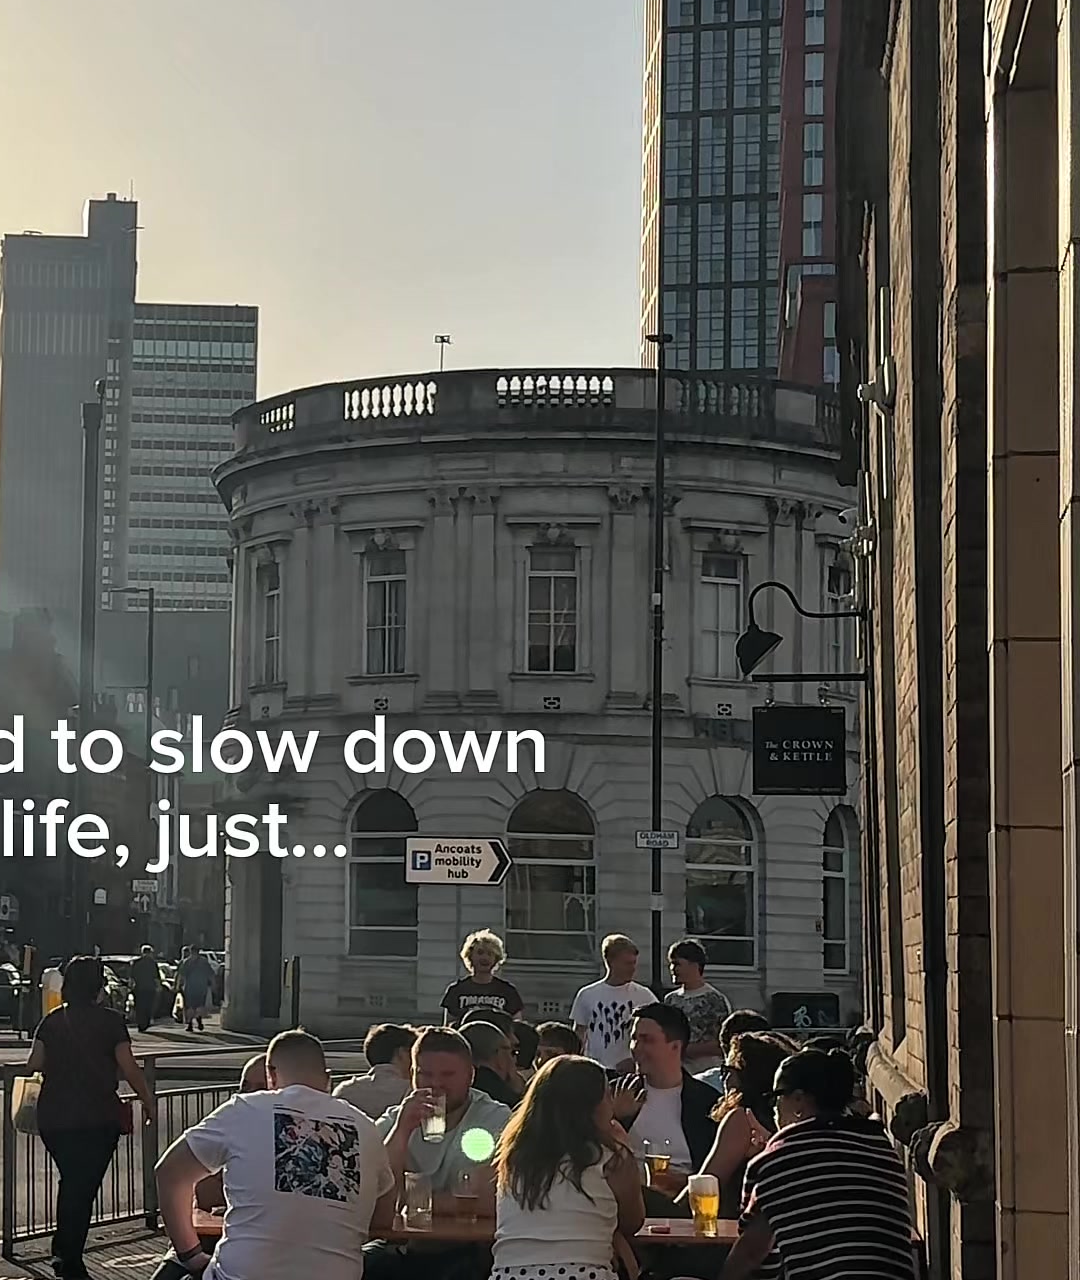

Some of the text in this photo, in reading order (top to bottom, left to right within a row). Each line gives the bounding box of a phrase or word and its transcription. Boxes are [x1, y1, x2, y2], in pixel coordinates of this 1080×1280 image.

[765, 740, 834, 750] The CROWN
[769, 752, 833, 761] & KETTLE
[434, 843, 482, 854] Ancoats
[415, 852, 429, 869] P
[434, 856, 482, 869] mobility
[447, 868, 469, 879] hub
